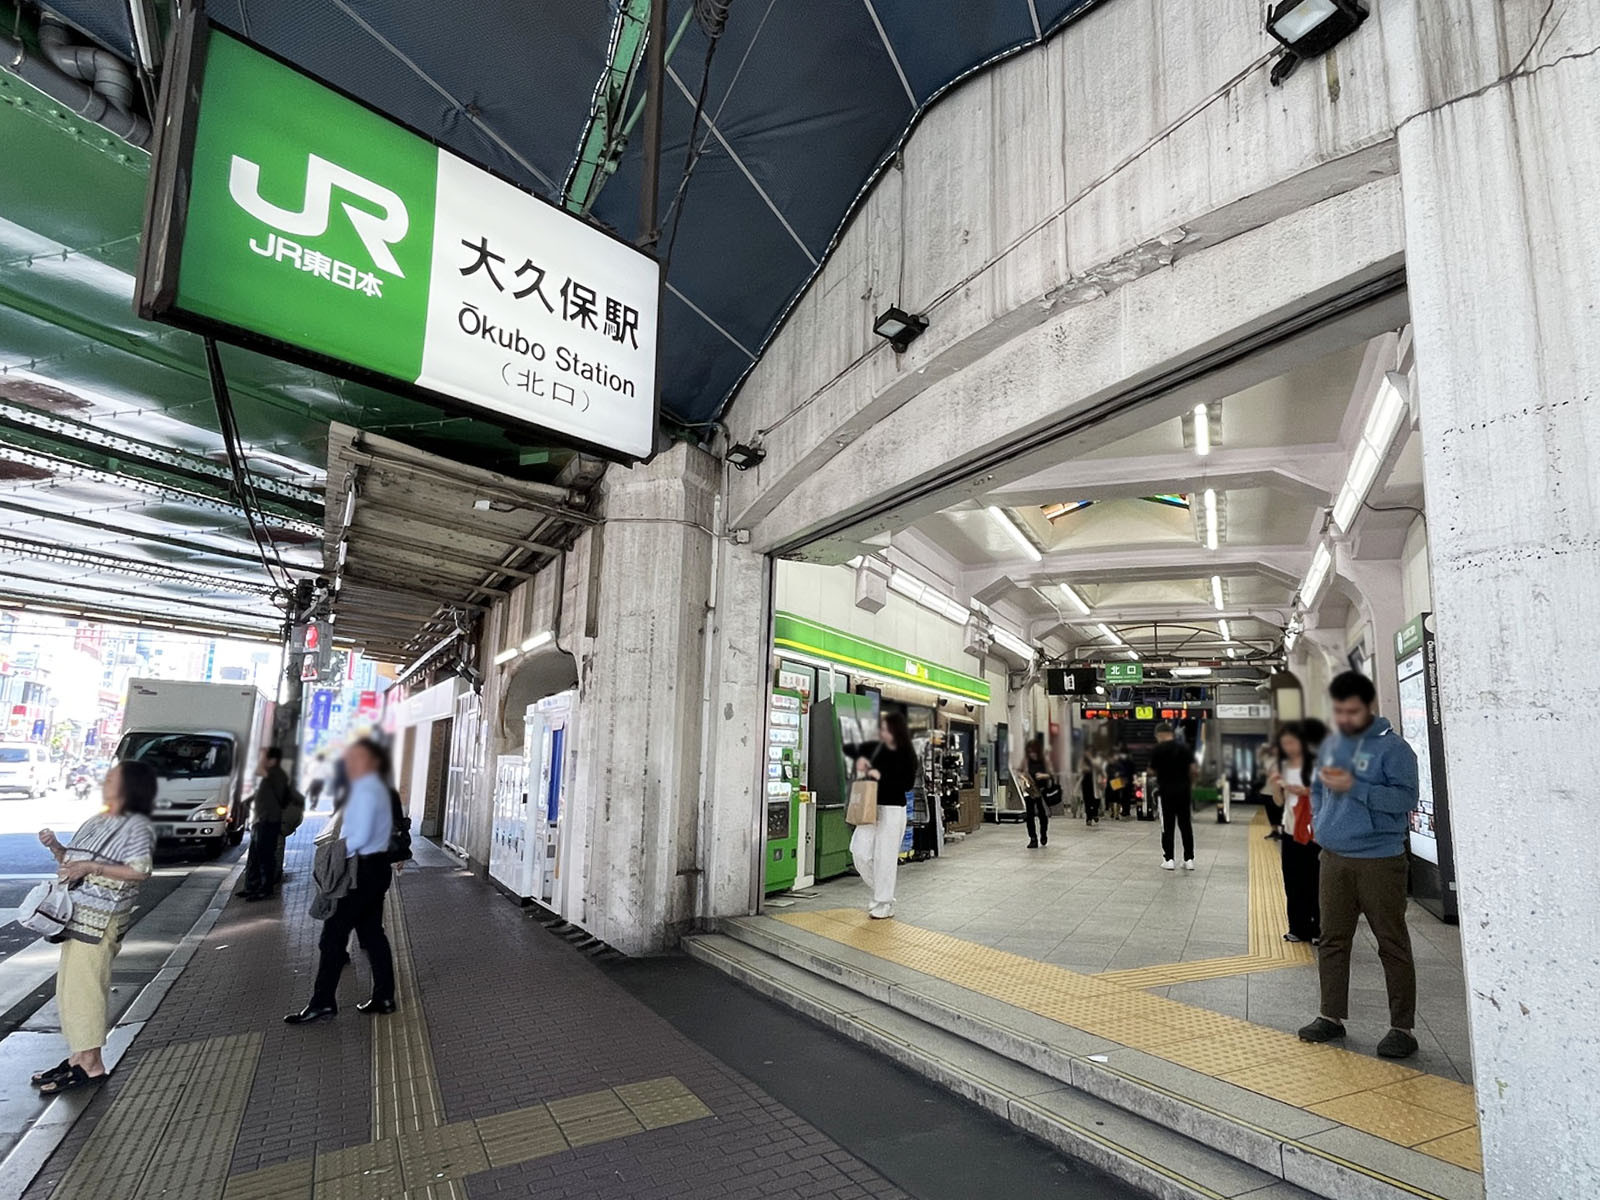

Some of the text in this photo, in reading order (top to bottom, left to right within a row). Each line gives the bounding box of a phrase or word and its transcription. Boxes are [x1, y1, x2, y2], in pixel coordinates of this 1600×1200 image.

[228, 153, 409, 279] JR
[249, 233, 384, 298] JR東日本
[459, 236, 639, 351] 大久保駅
[458, 301, 635, 398] Ōkubo Station
[1110, 665, 1137, 675] 北口
